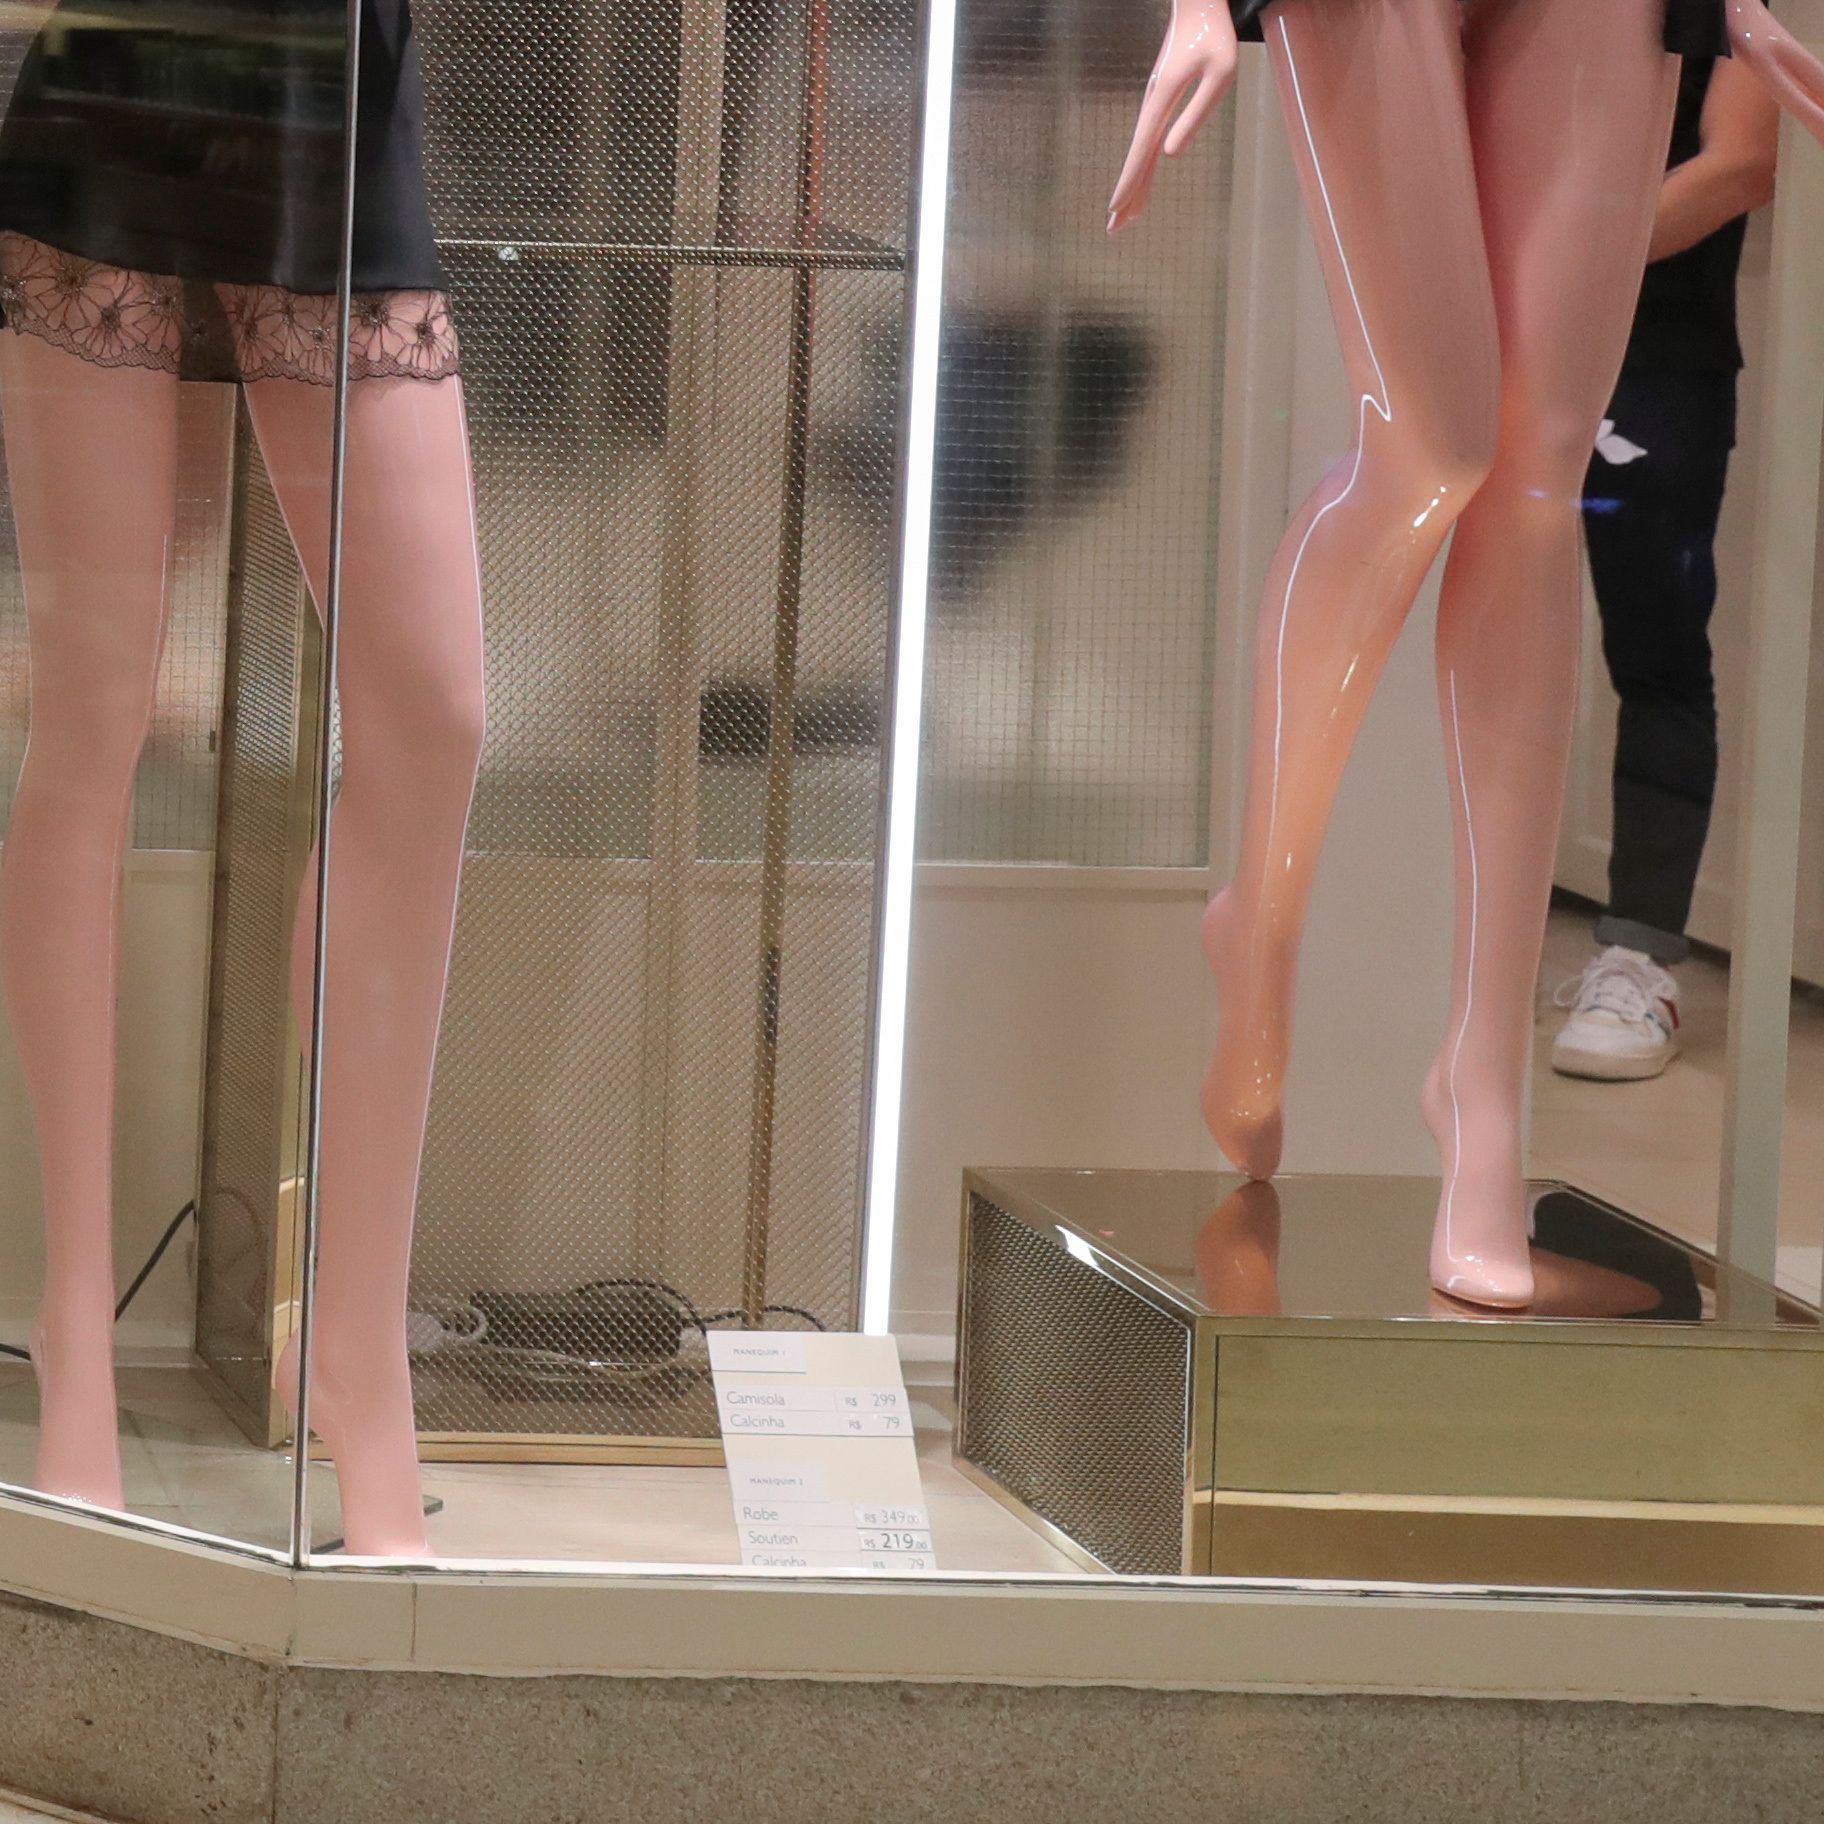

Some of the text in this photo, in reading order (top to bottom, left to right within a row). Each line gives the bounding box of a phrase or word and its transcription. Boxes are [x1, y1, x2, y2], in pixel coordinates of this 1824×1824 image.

[726, 1391, 897, 1408] Camisola R$ 299
[730, 1413, 785, 1429] Calcinha
[885, 1416, 901, 1430] 79
[743, 1507, 779, 1522] Robe
[748, 1531, 799, 1546] Soutien
